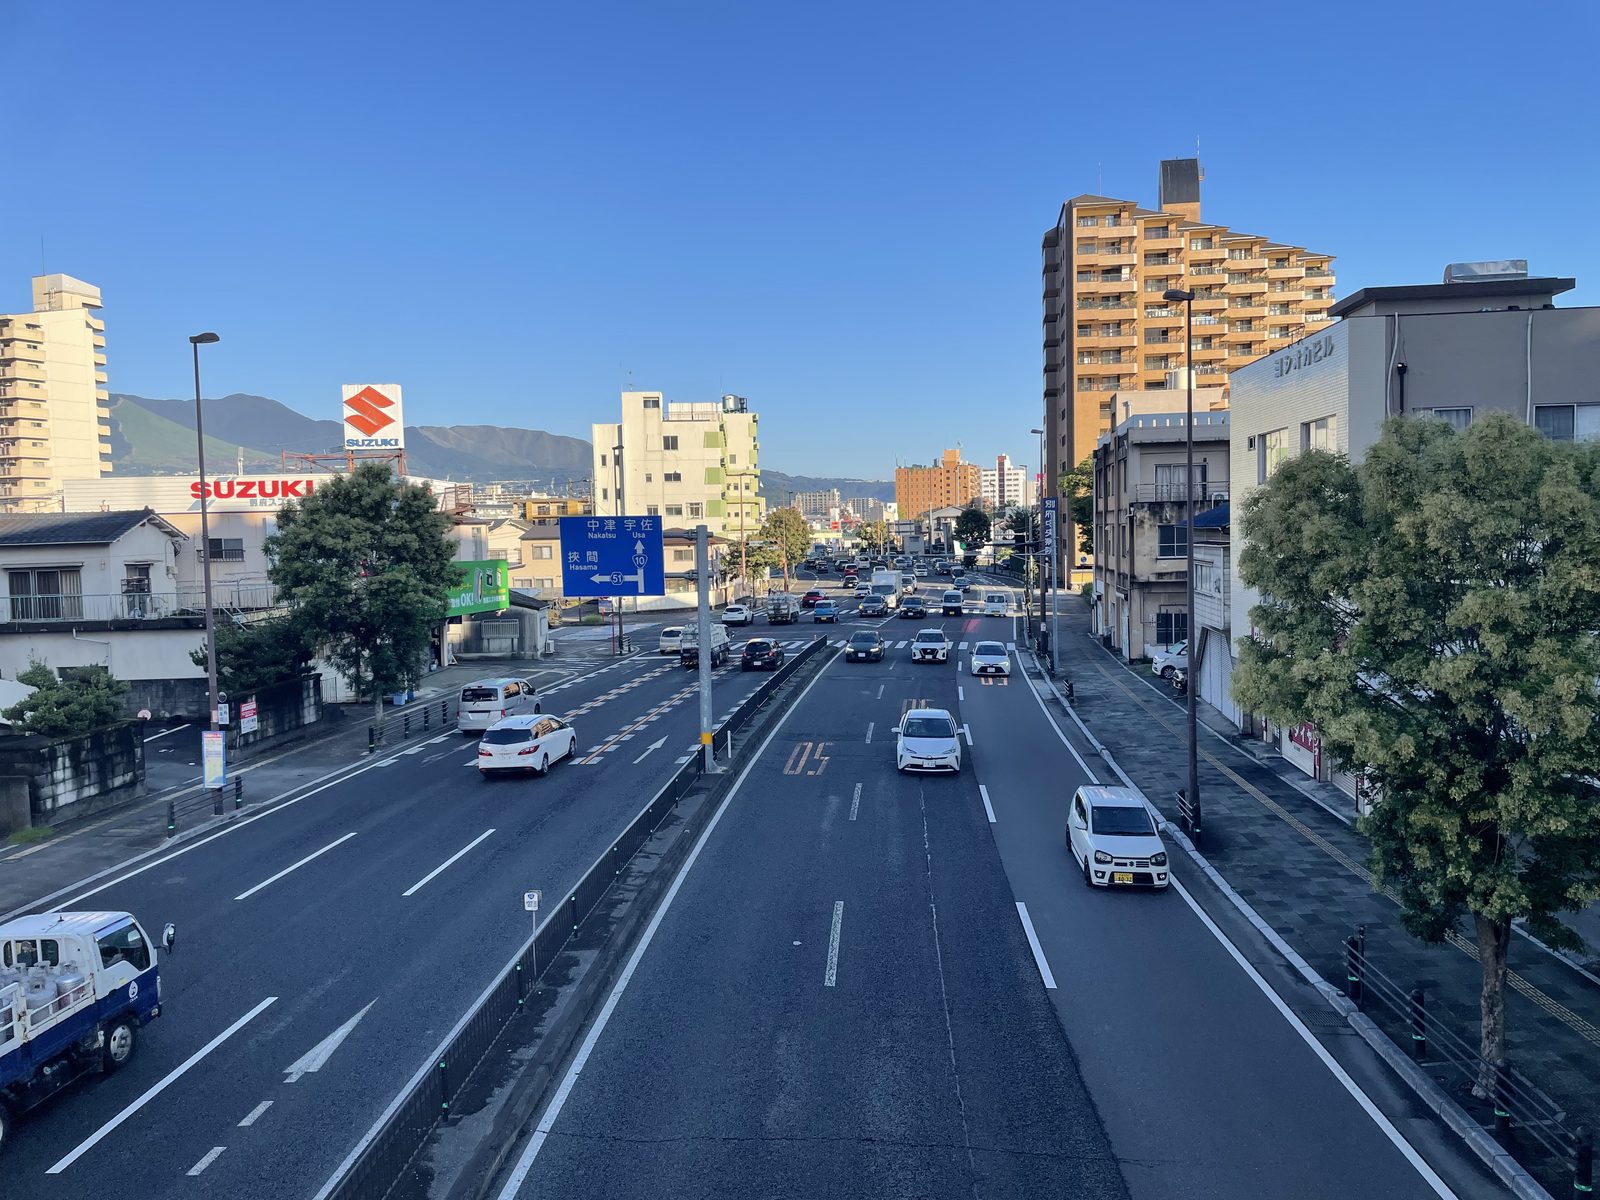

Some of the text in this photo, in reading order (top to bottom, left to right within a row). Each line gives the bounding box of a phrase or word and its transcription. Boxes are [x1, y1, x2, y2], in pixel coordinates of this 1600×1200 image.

[346, 438, 399, 447] SUZUKI
[190, 479, 315, 499] SUZUKI
[587, 518, 653, 532] 中津 宇佐
[632, 531, 646, 539] Usa
[635, 556, 645, 565] 10
[612, 574, 622, 583] 51
